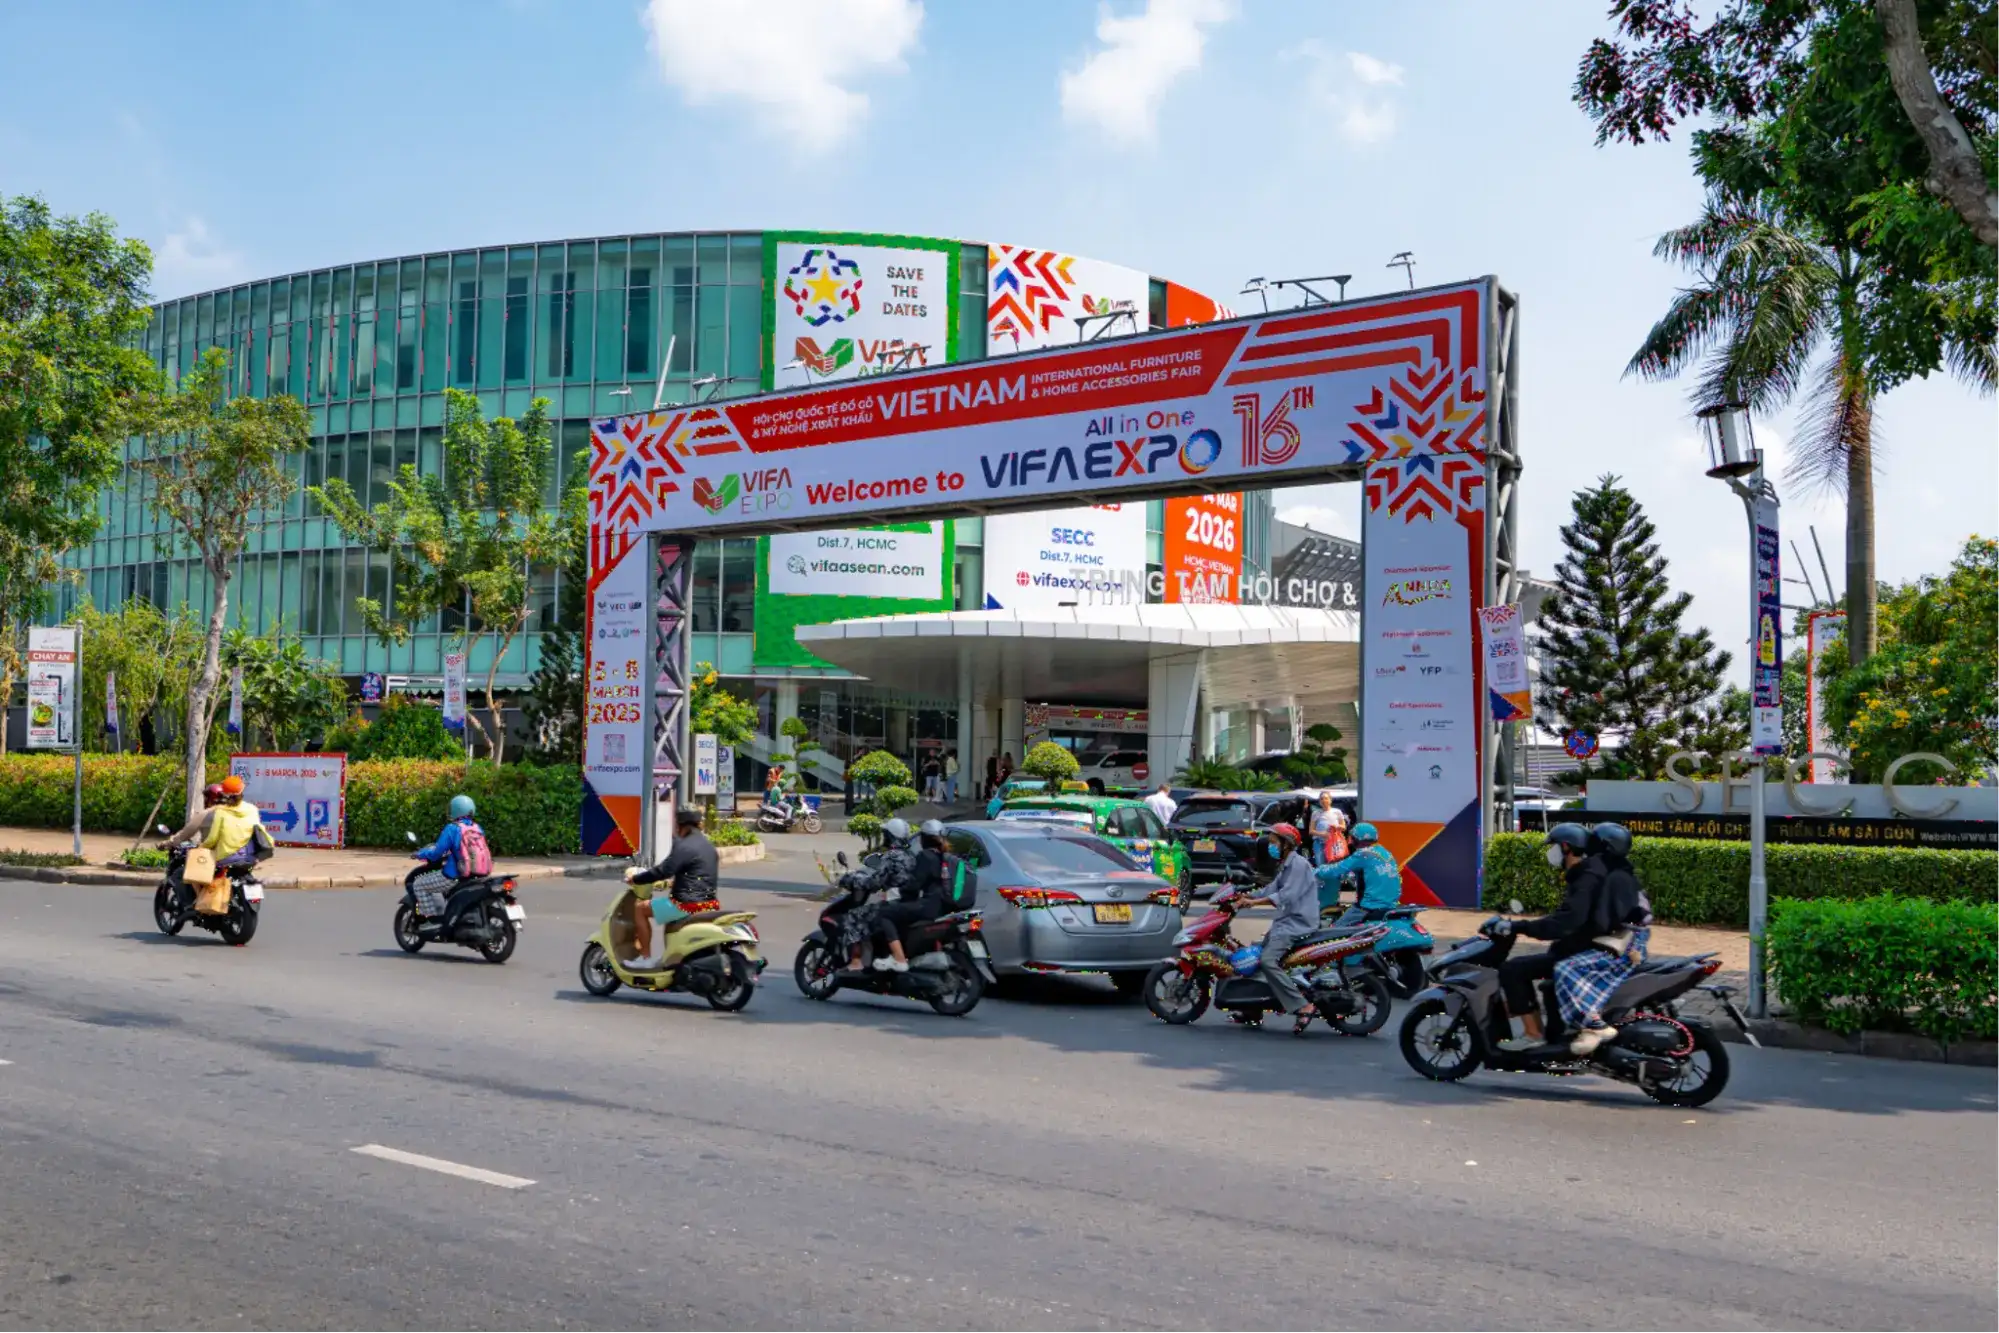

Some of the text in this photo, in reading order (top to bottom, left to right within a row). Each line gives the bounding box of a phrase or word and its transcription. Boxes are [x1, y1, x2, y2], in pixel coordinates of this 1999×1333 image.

[887, 266, 924, 281] SAVE
[891, 285, 918, 299] THE
[883, 302, 927, 318] DATES
[1031, 348, 1203, 385] INTERNATIONAL FURNITURE
[1031, 365, 1203, 399] & HOME ACCESSORIES FAIR
[878, 374, 1027, 420] VIETNAM
[1085, 409, 1196, 438] All in One
[742, 467, 793, 493] VIFA
[806, 470, 964, 505] Welcome to
[741, 491, 792, 515] EXPO
[1051, 527, 1095, 546] SECC
[1185, 506, 1235, 552] 2026
[857, 538, 897, 551] HCMC
[810, 558, 925, 577] vifaasean.com
[1075, 553, 1104, 565] HCMC
[1174, 567, 1229, 600] TÂM
[1342, 582, 1357, 605] &
[592, 685, 639, 698] MARCH
[590, 703, 640, 724] 2025
